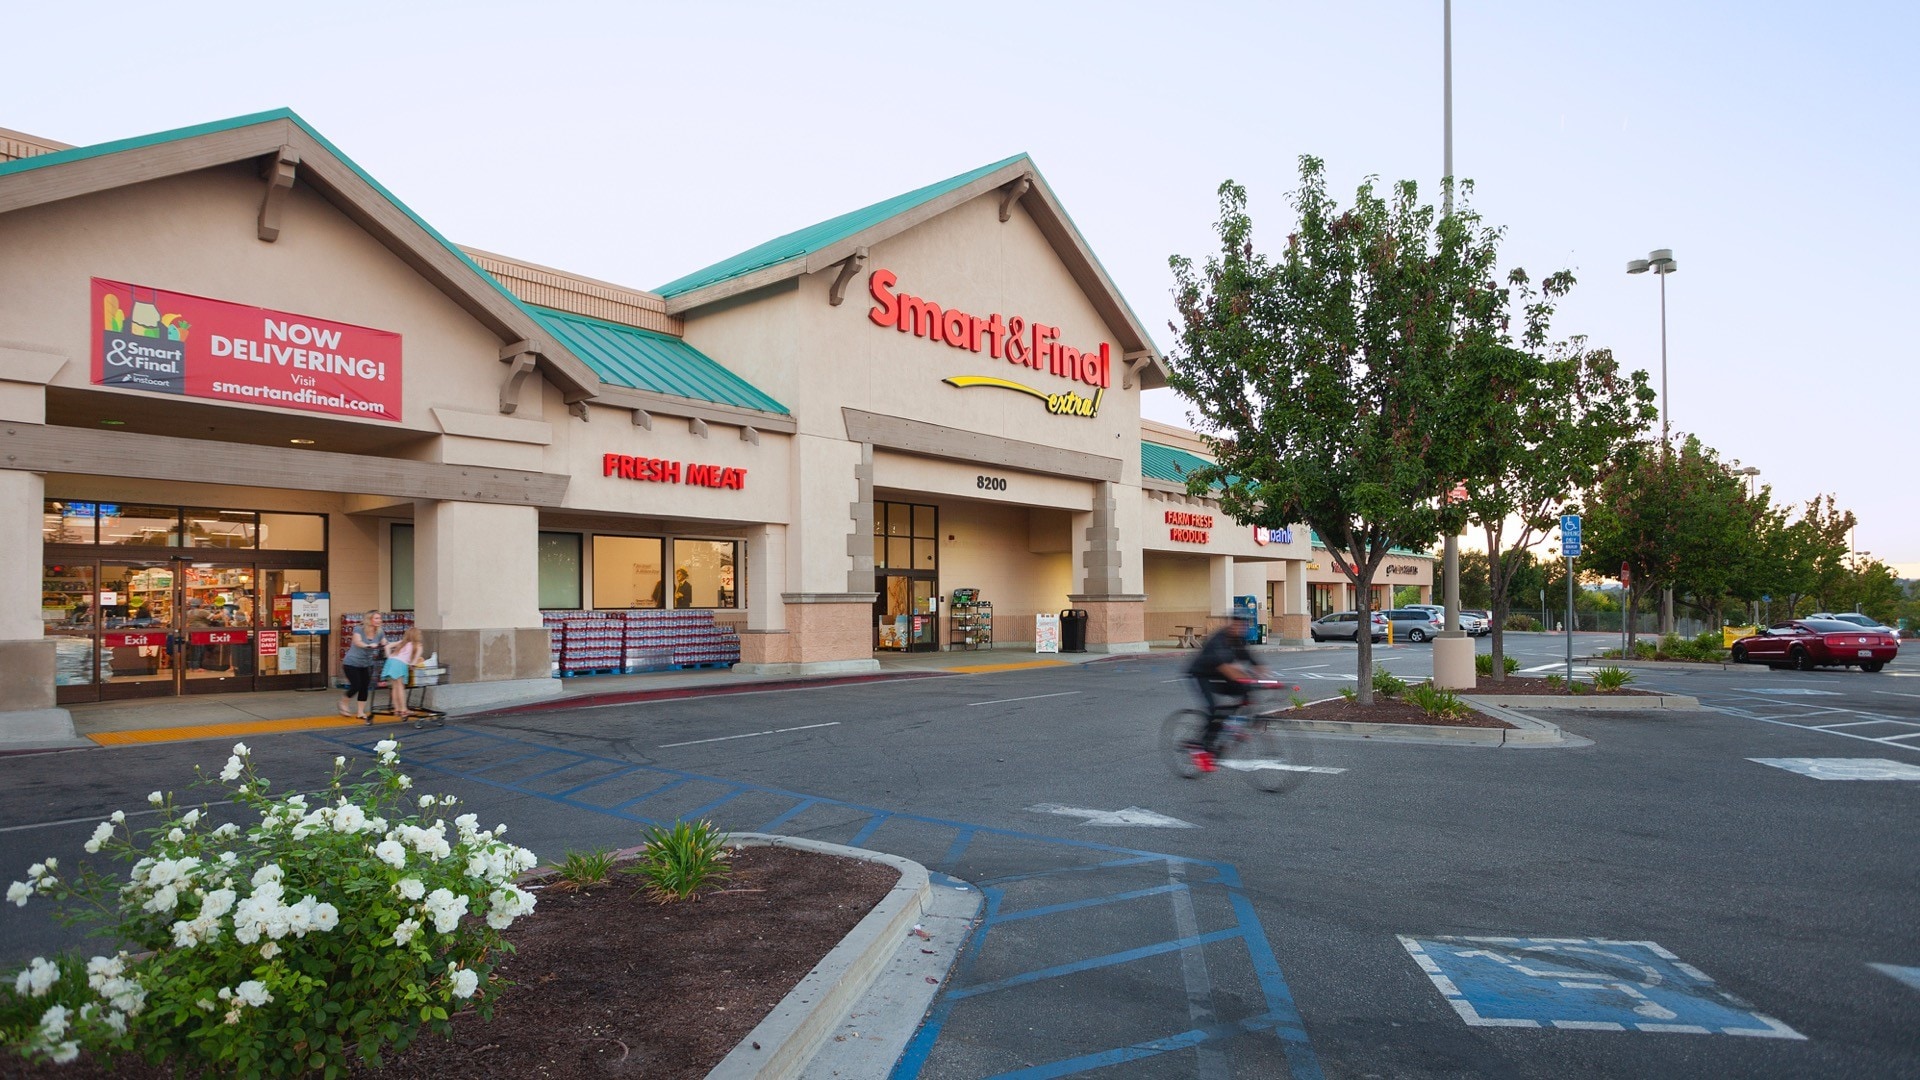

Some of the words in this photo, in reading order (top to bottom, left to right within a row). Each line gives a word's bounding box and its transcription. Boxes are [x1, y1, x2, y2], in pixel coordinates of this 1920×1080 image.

[264, 318, 341, 350] NOW
[868, 268, 1110, 389] Smart&Final
[128, 341, 182, 361] Smart
[211, 334, 385, 382] DELIVERING!
[133, 376, 170, 387] instacart
[290, 373, 316, 387] Visit
[212, 381, 385, 413] smartandfinal.com
[1046, 387, 1104, 418] extra!
[603, 453, 681, 484] FRESH
[685, 463, 748, 490] MEAT
[976, 475, 1007, 491] 8200
[1165, 510, 1191, 526] FARM
[1191, 514, 1213, 528] FRESH
[1170, 528, 1210, 544] PRODUCE
[124, 635, 148, 645] Exit
[209, 633, 231, 643] Exit
